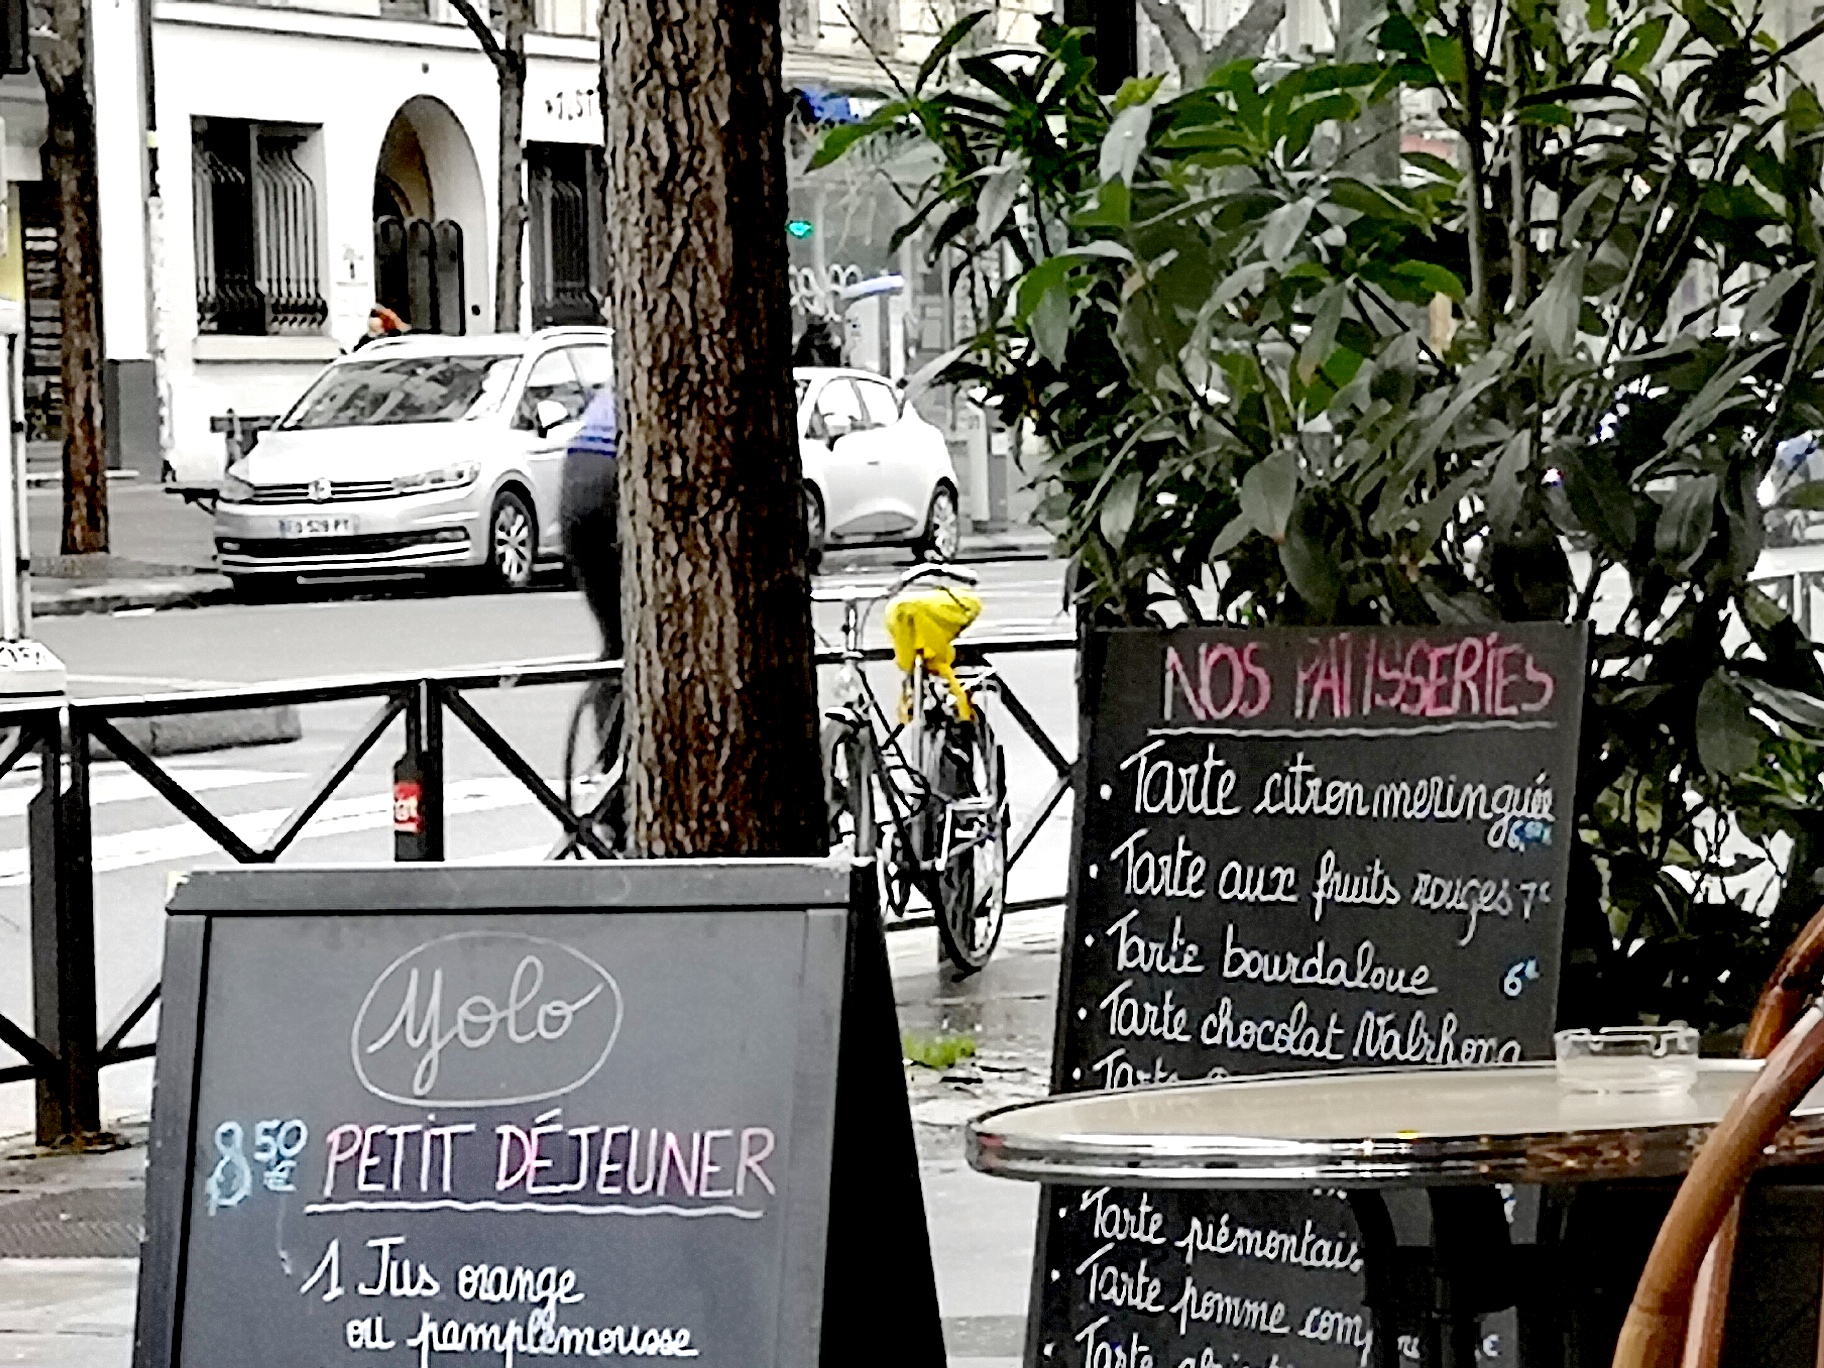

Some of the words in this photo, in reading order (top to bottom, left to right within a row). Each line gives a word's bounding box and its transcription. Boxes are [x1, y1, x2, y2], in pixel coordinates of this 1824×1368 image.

[1163, 641, 1271, 721] NOS
[1120, 739, 1242, 817] Tarte
[1254, 752, 1370, 817] citron
[1110, 827, 1206, 899] Tarte
[1218, 858, 1299, 902] aux
[1313, 849, 1401, 922] fruits
[1411, 871, 1513, 947] rouges
[1105, 908, 1205, 976] Tarte
[1221, 922, 1439, 996] bourdaloue
[367, 955, 603, 1096] Yolo
[1100, 978, 1192, 1042] Tarte
[1200, 996, 1345, 1061] chocolat
[324, 1112, 477, 1198] PETIT
[494, 1108, 777, 1198] DÉJEUNER
[1078, 1187, 1167, 1245] Tarte
[1174, 1213, 1365, 1273] piémontais
[299, 1237, 345, 1302] 1
[357, 1235, 441, 1298] Jus
[457, 1264, 585, 1319] orange
[1076, 1242, 1166, 1312] Tarte
[1170, 1272, 1291, 1336] pomme
[346, 1322, 394, 1352] ou
